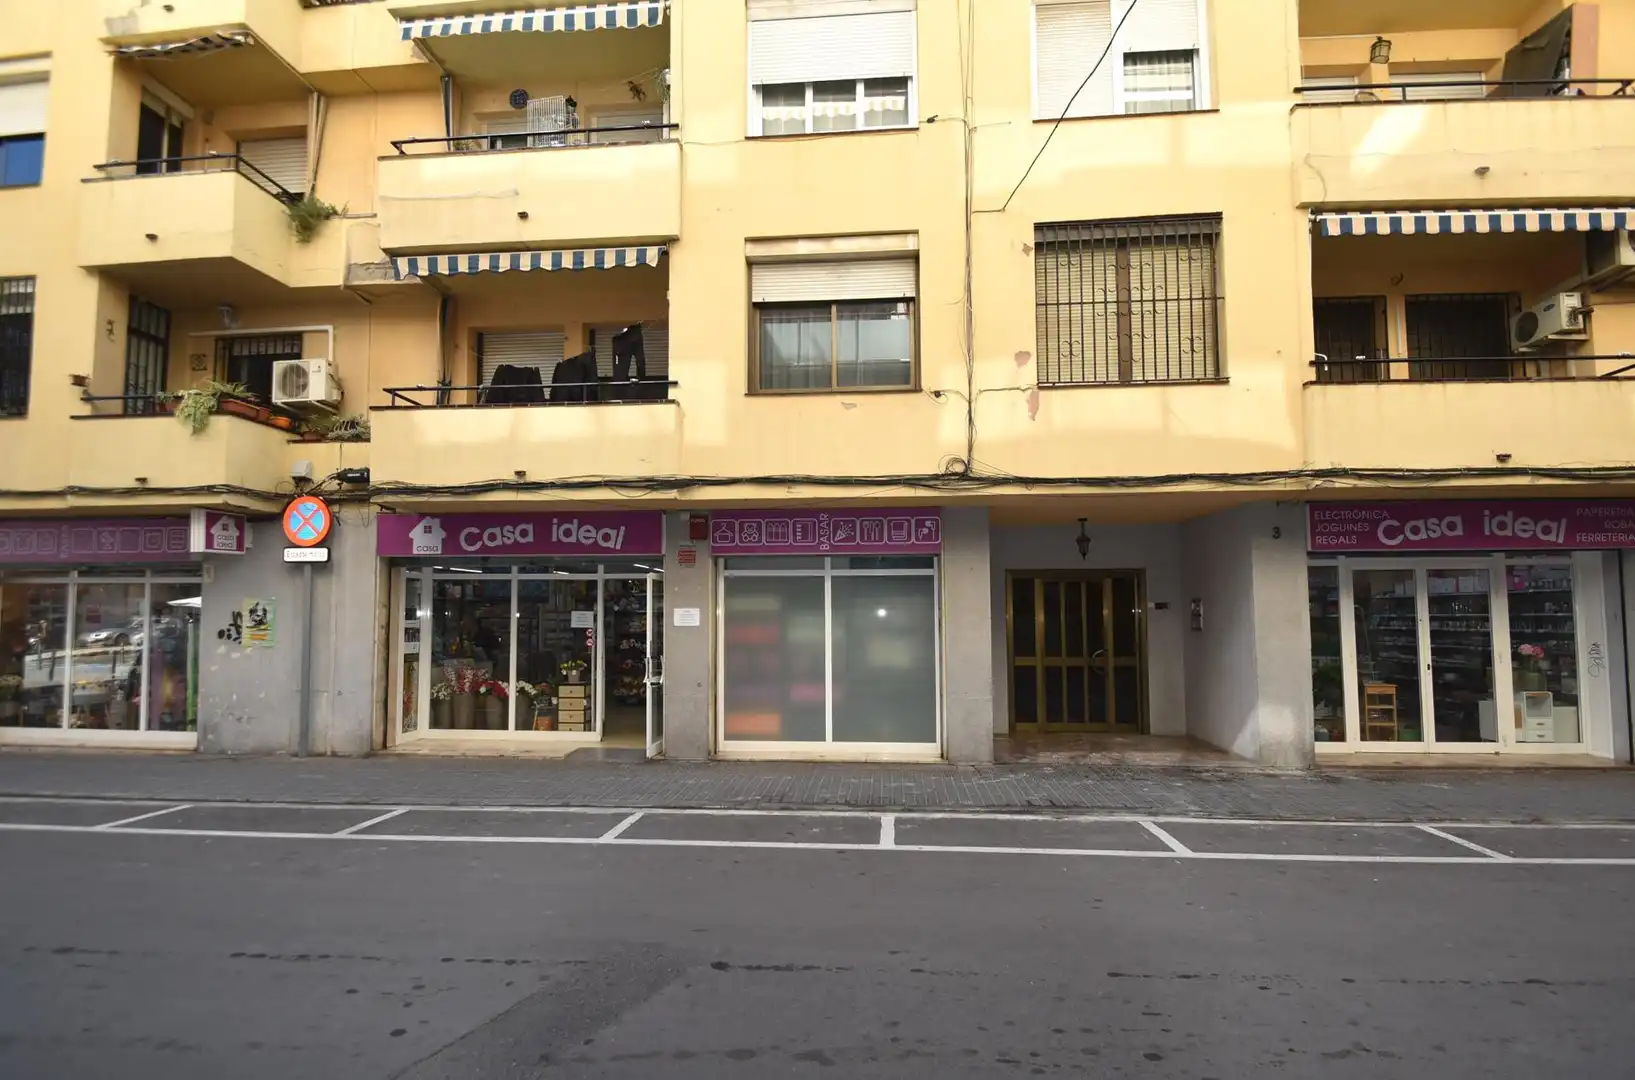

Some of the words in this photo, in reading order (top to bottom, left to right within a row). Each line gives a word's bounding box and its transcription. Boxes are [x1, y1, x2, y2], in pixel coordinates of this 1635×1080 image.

[551, 518, 626, 550] ideal
[819, 512, 830, 550] BASAR
[1272, 526, 1282, 540] 3
[1482, 508, 1567, 544] ideal
[416, 544, 439, 553] casa
[1315, 534, 1358, 545] REGALS
